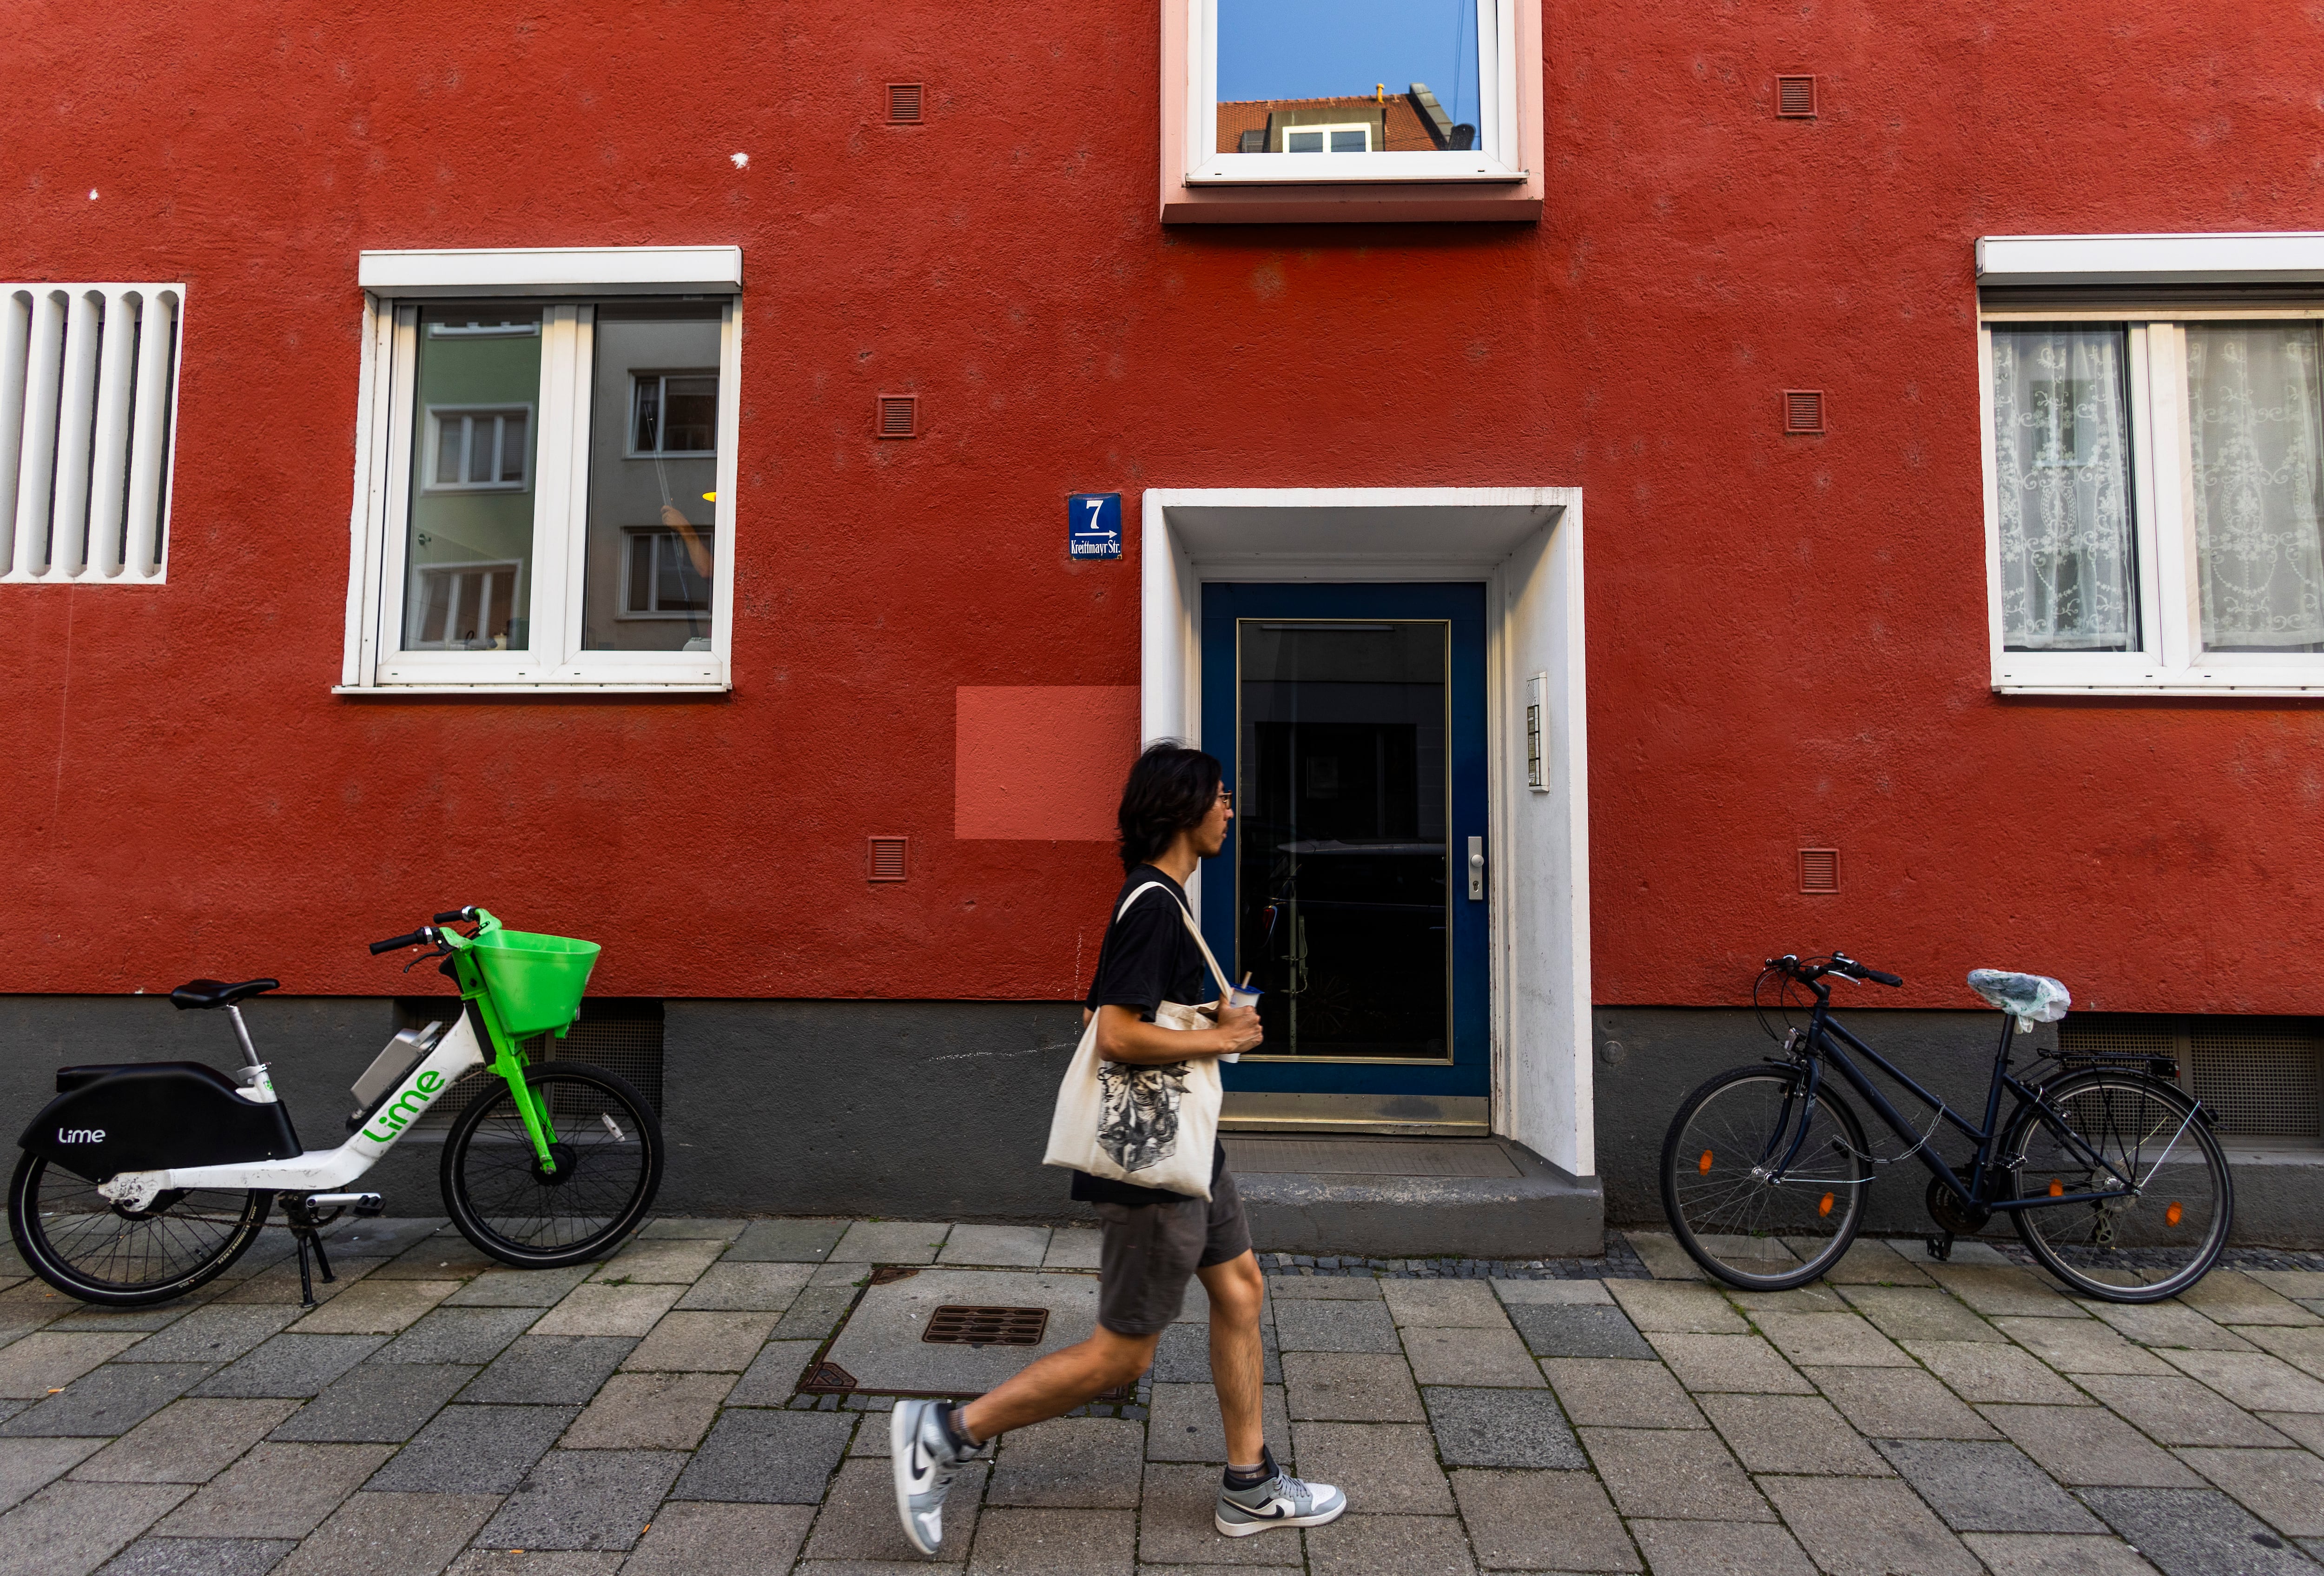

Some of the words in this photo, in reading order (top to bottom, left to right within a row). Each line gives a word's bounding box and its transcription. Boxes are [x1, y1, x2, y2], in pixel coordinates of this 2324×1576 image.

[1086, 500, 1104, 529] 7
[1071, 540, 1108, 556] Kreittmayr
[1108, 539, 1121, 553] Str.
[362, 1071, 445, 1143] Lime
[59, 1127, 106, 1143] Lime
